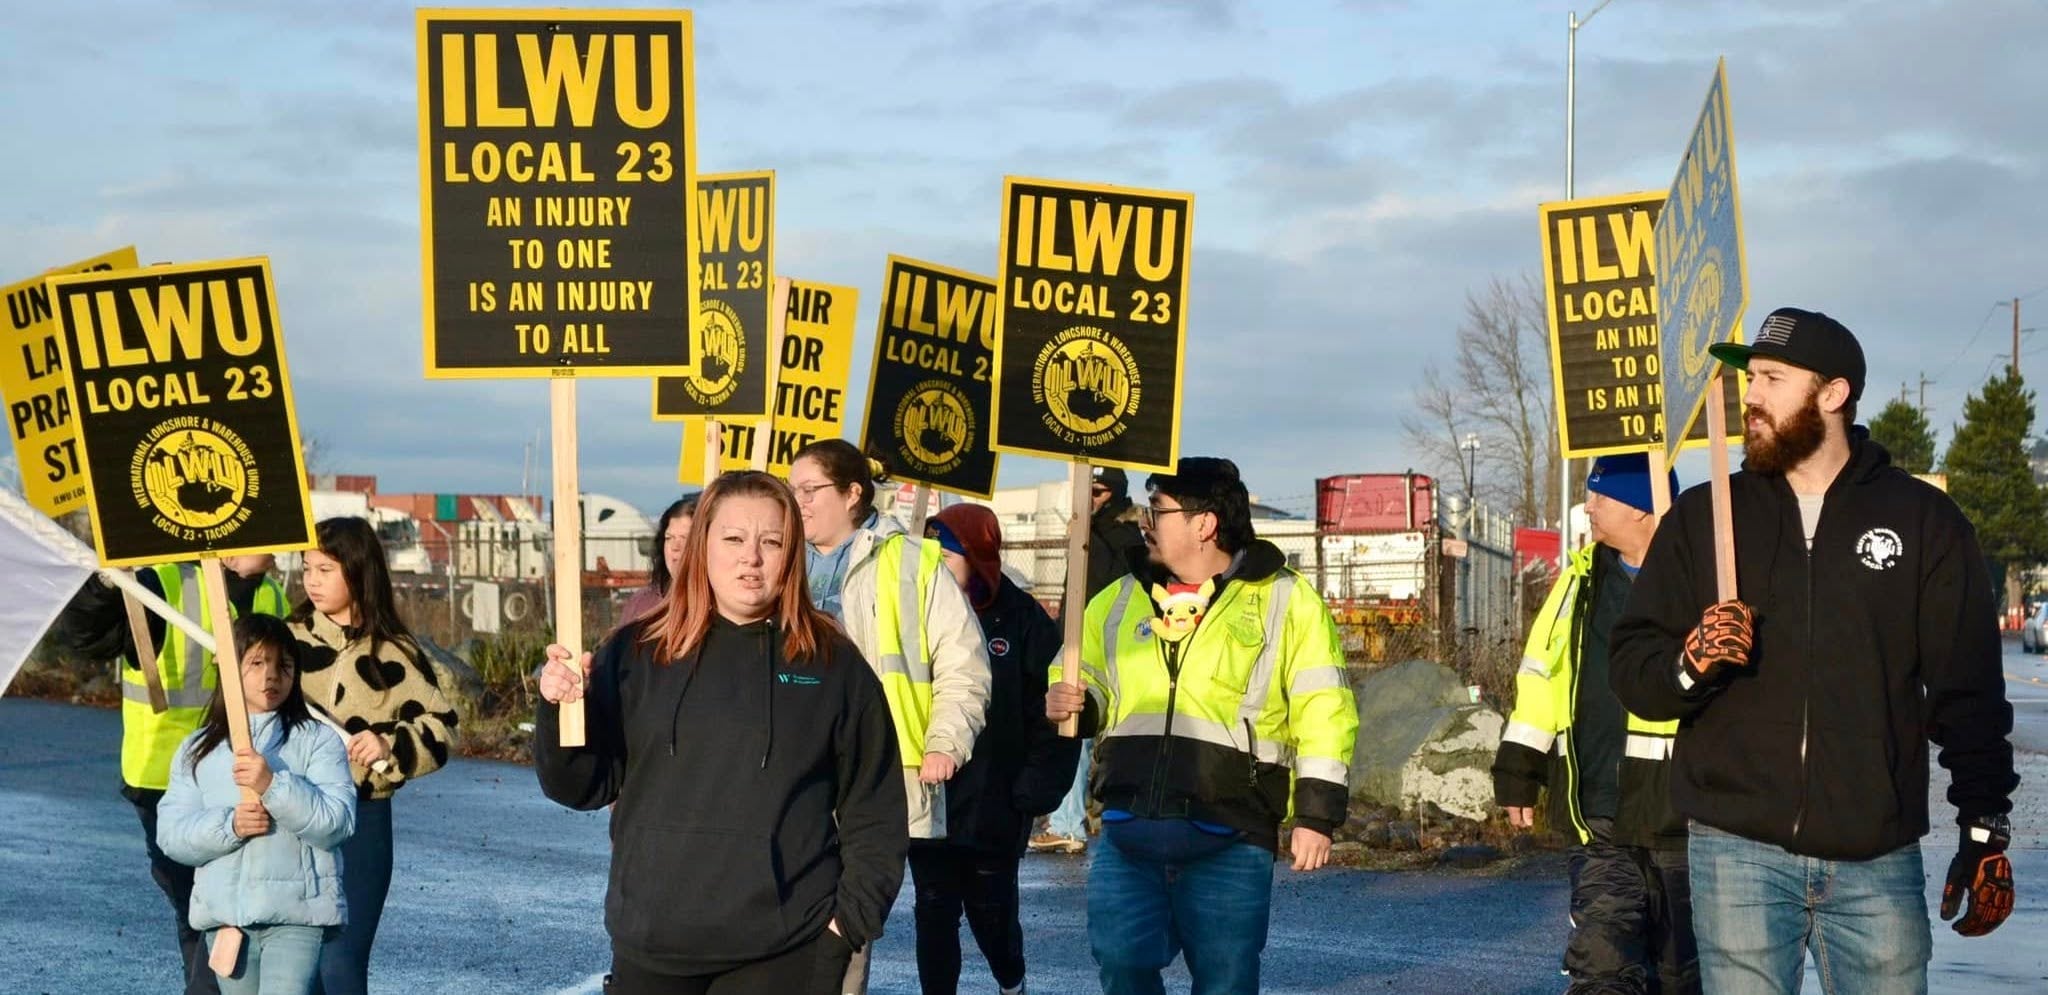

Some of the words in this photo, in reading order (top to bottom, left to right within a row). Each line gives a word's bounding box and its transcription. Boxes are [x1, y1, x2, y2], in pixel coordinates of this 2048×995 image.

[441, 33, 672, 129] ILWU
[444, 141, 596, 183] LOCAL
[616, 141, 674, 182] 23
[486, 196, 521, 227] AN
[535, 196, 632, 227] INJURY
[1659, 89, 1722, 289] ILWU
[697, 186, 765, 253] WU
[1016, 194, 1177, 282] ILWU
[508, 239, 545, 269] TO
[557, 239, 612, 269] ONE
[1663, 217, 1707, 326] LOCAL
[1710, 161, 1728, 218] 23
[469, 282, 497, 312] IS
[509, 282, 544, 312] AN
[557, 281, 654, 311] INJURY
[737, 260, 763, 290] 23
[69, 278, 263, 370] ILWU
[1013, 277, 1116, 318] LOCAL
[1129, 290, 1171, 324] 23
[515, 324, 551, 354] TO
[562, 324, 611, 354] ALL
[886, 335, 963, 376] LOCAL
[973, 356, 993, 382] 2
[1596, 328, 1620, 350] AN
[85, 371, 210, 414] LOCAL
[224, 365, 273, 400] 23
[1032, 340, 1057, 404] INTERNATIONAL
[1054, 325, 1102, 345] LONGSHORE
[1102, 331, 1110, 342] &
[1110, 336, 1141, 385] WAREHOUSE
[1127, 387, 1141, 416] UNION
[1050, 357, 1122, 405] ILWU
[1612, 356, 1638, 378] TO
[1588, 389, 1608, 411] IS
[1615, 385, 1639, 408] AN
[1042, 412, 1064, 437] LOCAL
[1064, 431, 1075, 443] 23
[1083, 430, 1115, 446] TACOMA
[1112, 421, 1127, 436] WA
[1620, 415, 1646, 437] TO
[130, 440, 152, 508] INTERNATIONAL
[146, 415, 200, 441] LONGSHORE
[201, 418, 209, 429] &
[211, 420, 256, 467] WAREHOUSE
[247, 468, 260, 498] UNION
[150, 447, 239, 499] ILWU
[152, 514, 180, 537] LOCAL
[183, 529, 195, 541] 23
[204, 519, 241, 540] TACOMA
[236, 507, 253, 522] WA
